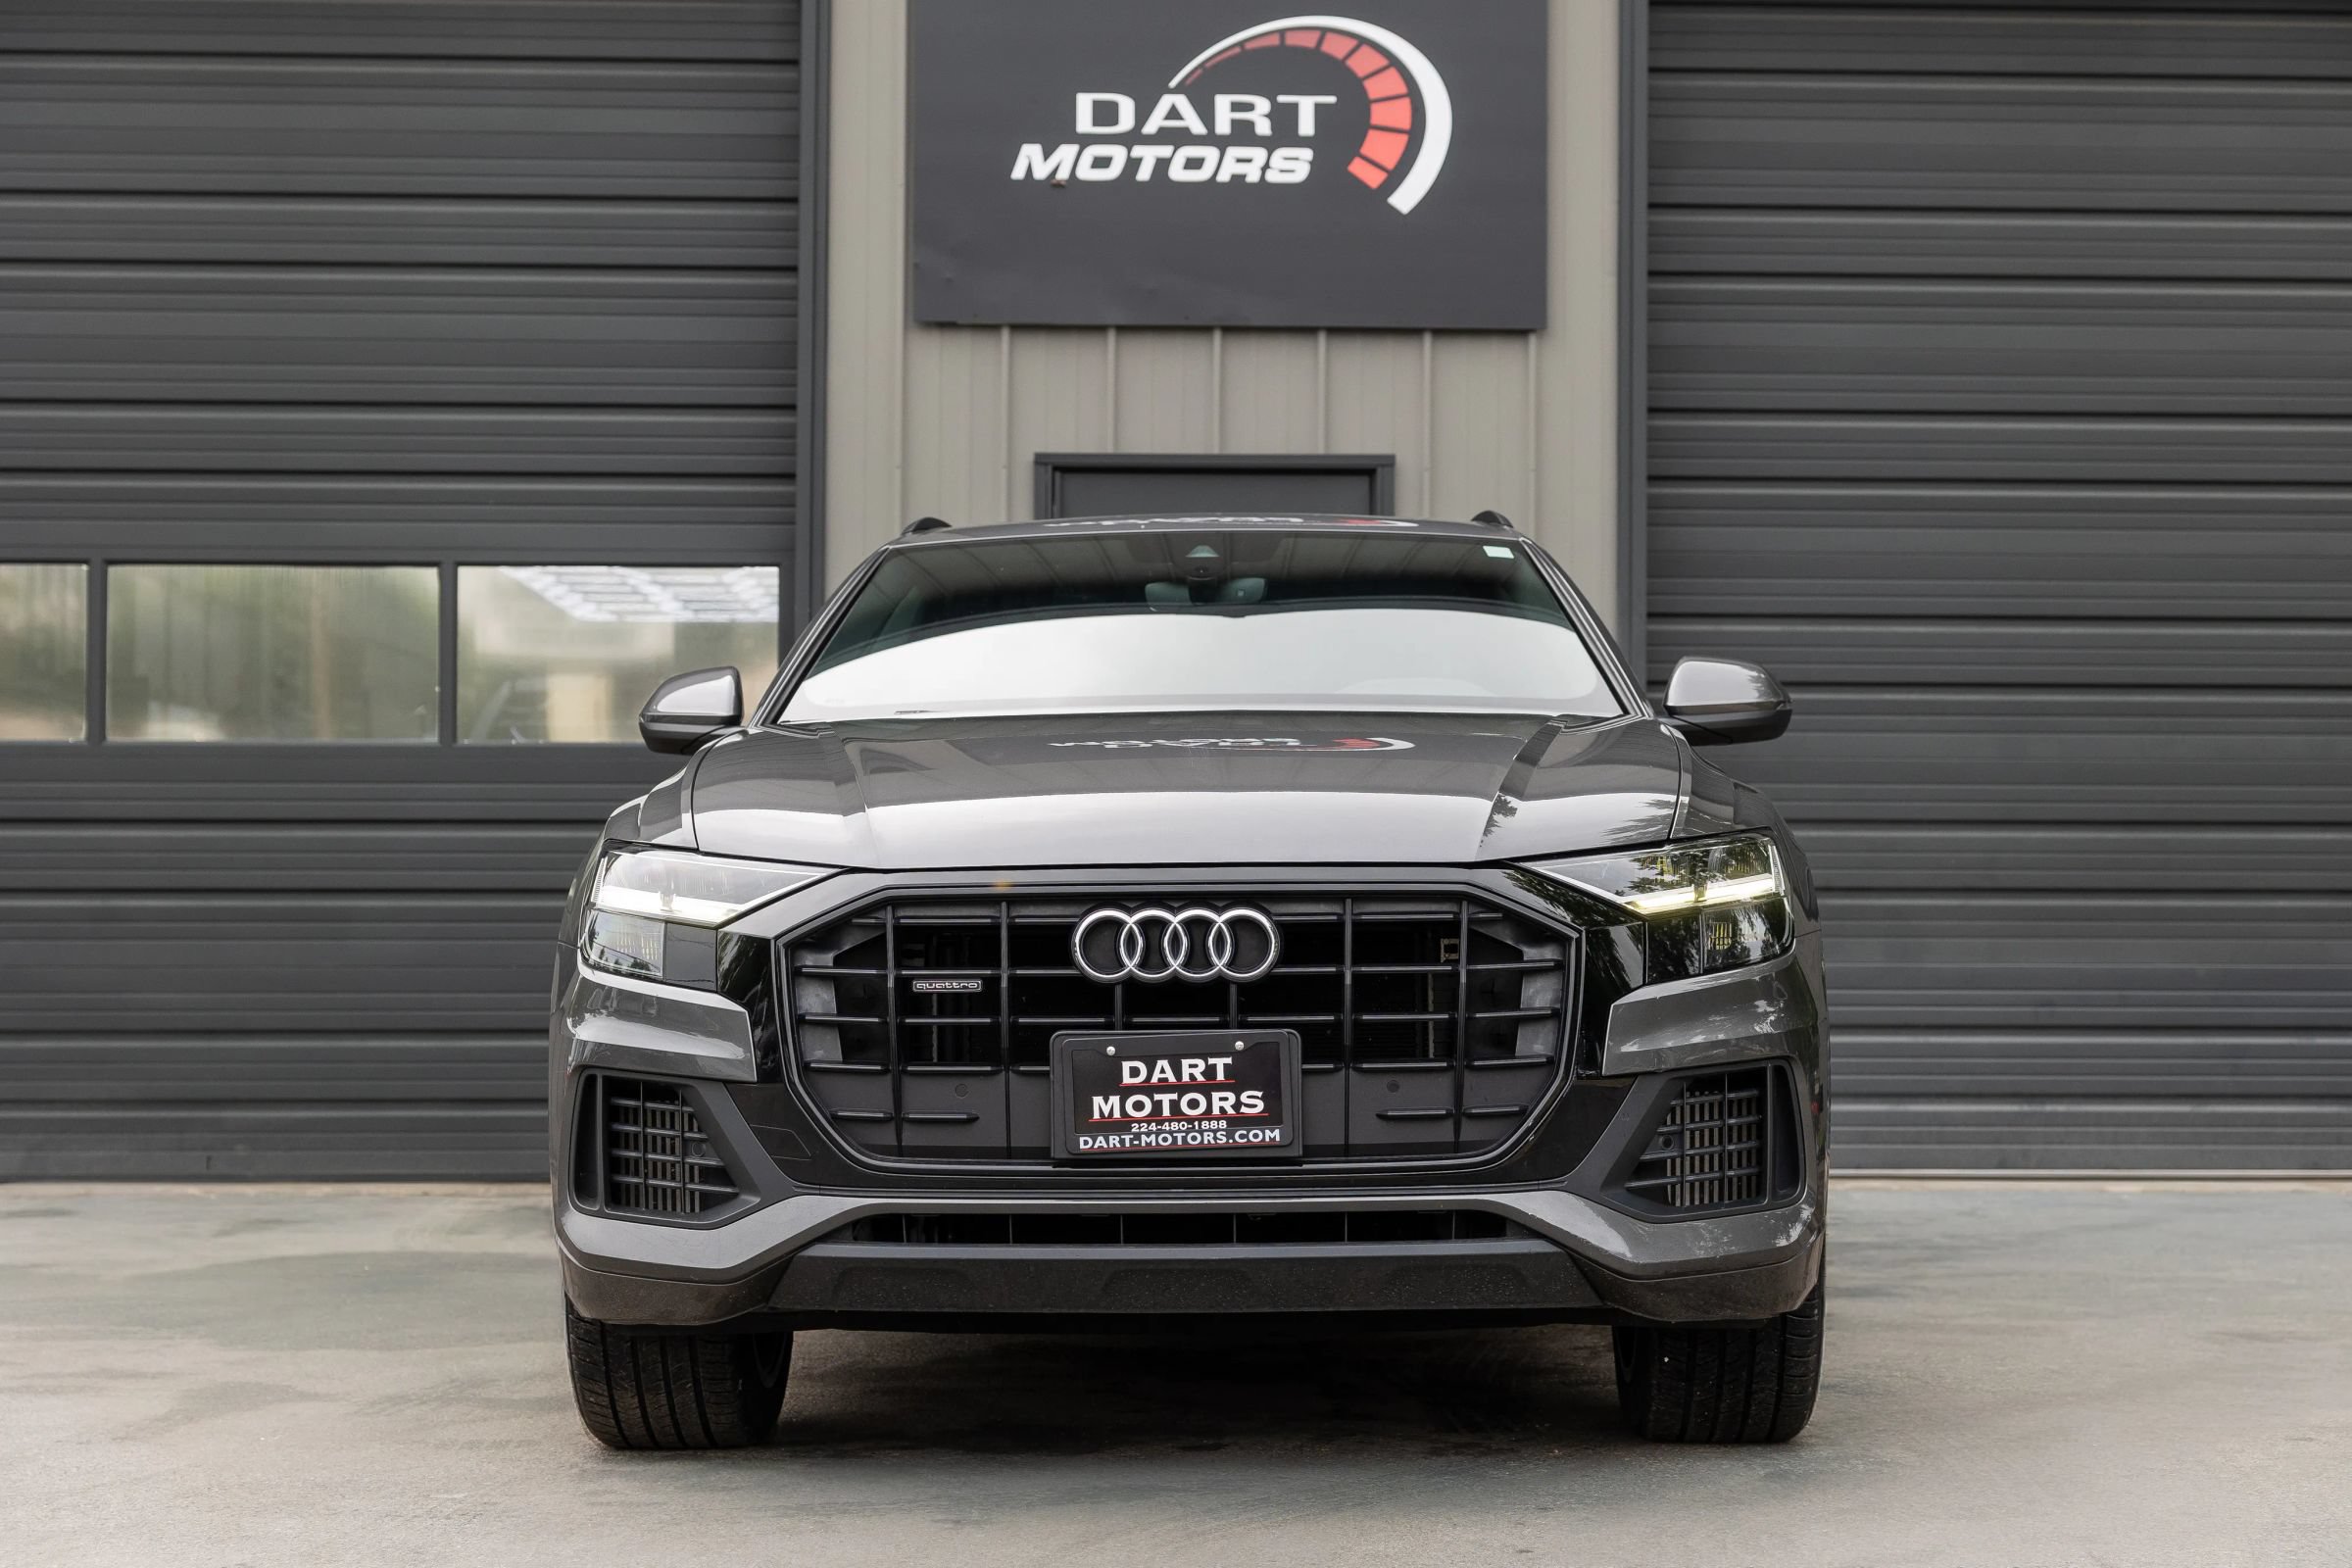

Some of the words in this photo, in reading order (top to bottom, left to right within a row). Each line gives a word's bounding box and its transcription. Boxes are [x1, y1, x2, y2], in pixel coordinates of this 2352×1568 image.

[1076, 92, 1337, 136] DART
[1010, 144, 1314, 183] MOTORS
[1121, 1056, 1233, 1085] DART
[1092, 1090, 1265, 1119] MOTORS
[1079, 1129, 1281, 1150] DART-MOTORS.COM
[1131, 1120, 1227, 1132] 224-480-1888
